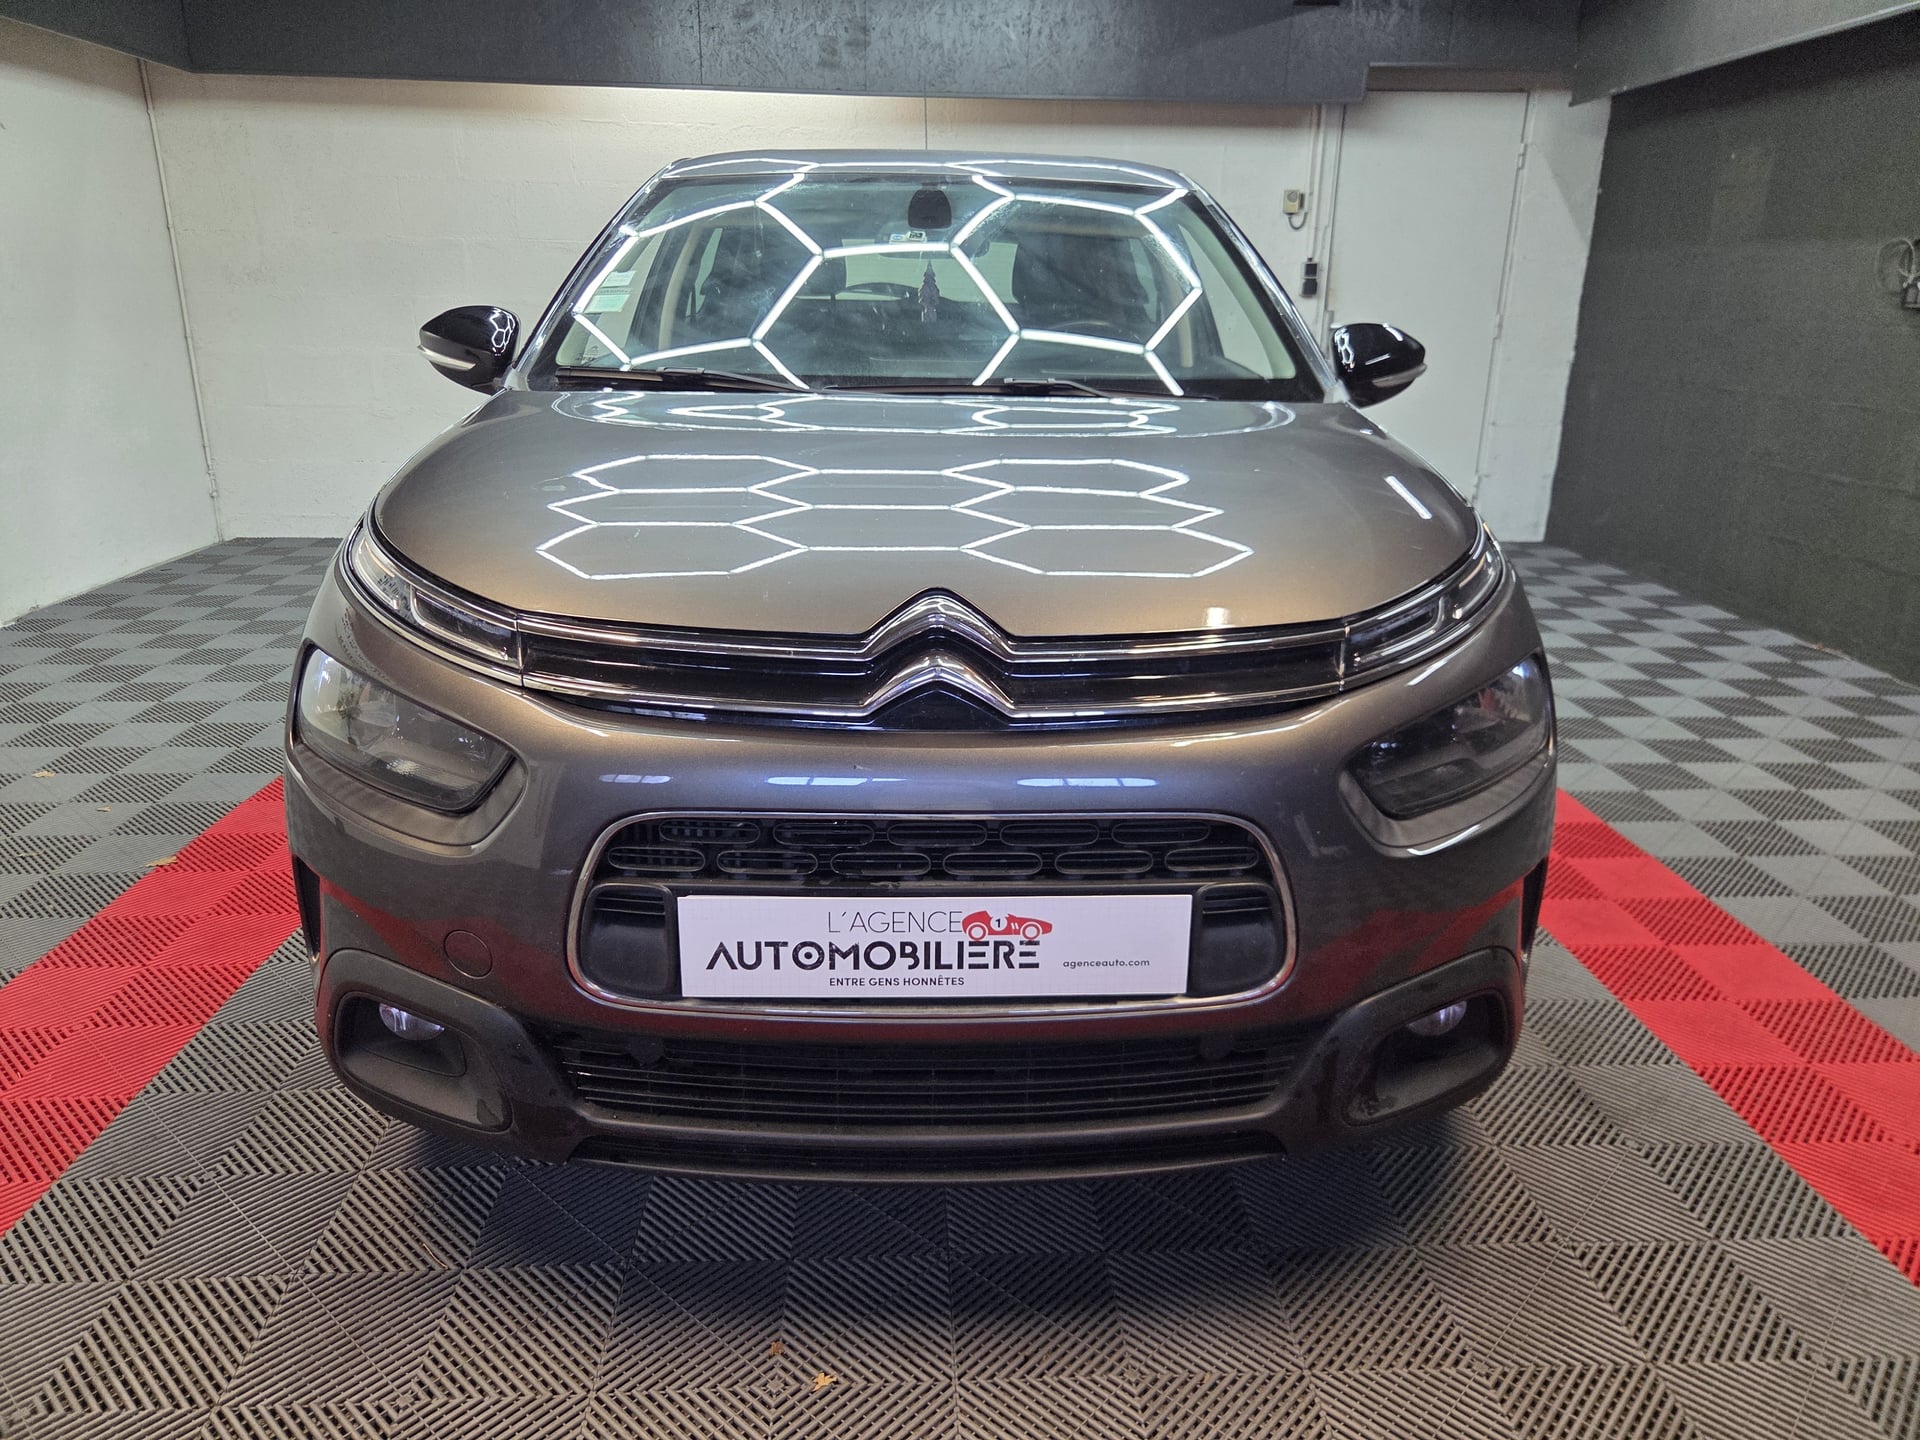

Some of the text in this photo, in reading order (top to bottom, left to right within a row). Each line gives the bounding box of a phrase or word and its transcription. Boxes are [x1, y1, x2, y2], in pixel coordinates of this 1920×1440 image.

[828, 911, 962, 933] L'AGENCE
[1063, 958, 1150, 968] agenceauto.com
[829, 975, 965, 986] ENTRE GENS HONNÊTES
